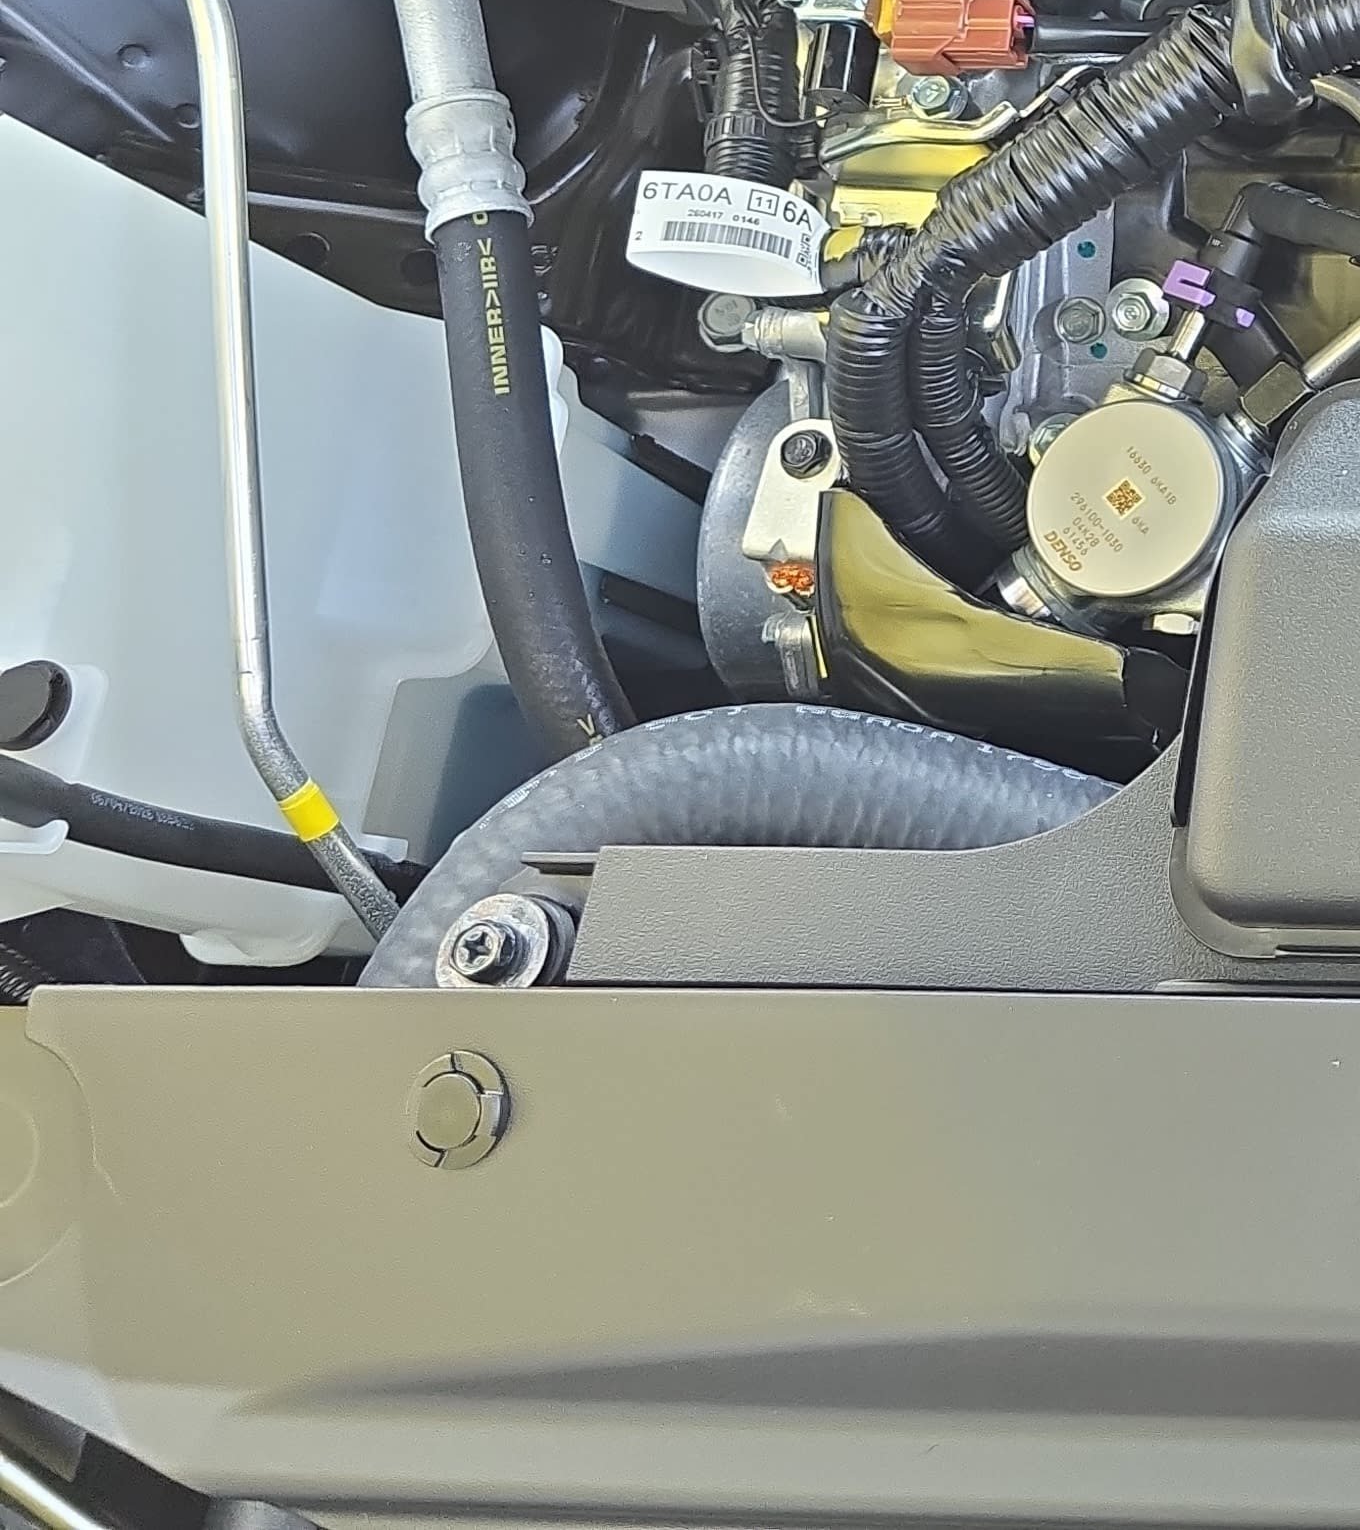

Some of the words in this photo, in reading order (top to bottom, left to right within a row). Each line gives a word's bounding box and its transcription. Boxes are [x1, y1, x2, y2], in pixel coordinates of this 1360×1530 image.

[642, 181, 733, 206] 6TA0A
[782, 200, 813, 232] 6A
[1042, 528, 1083, 573] DENSO
